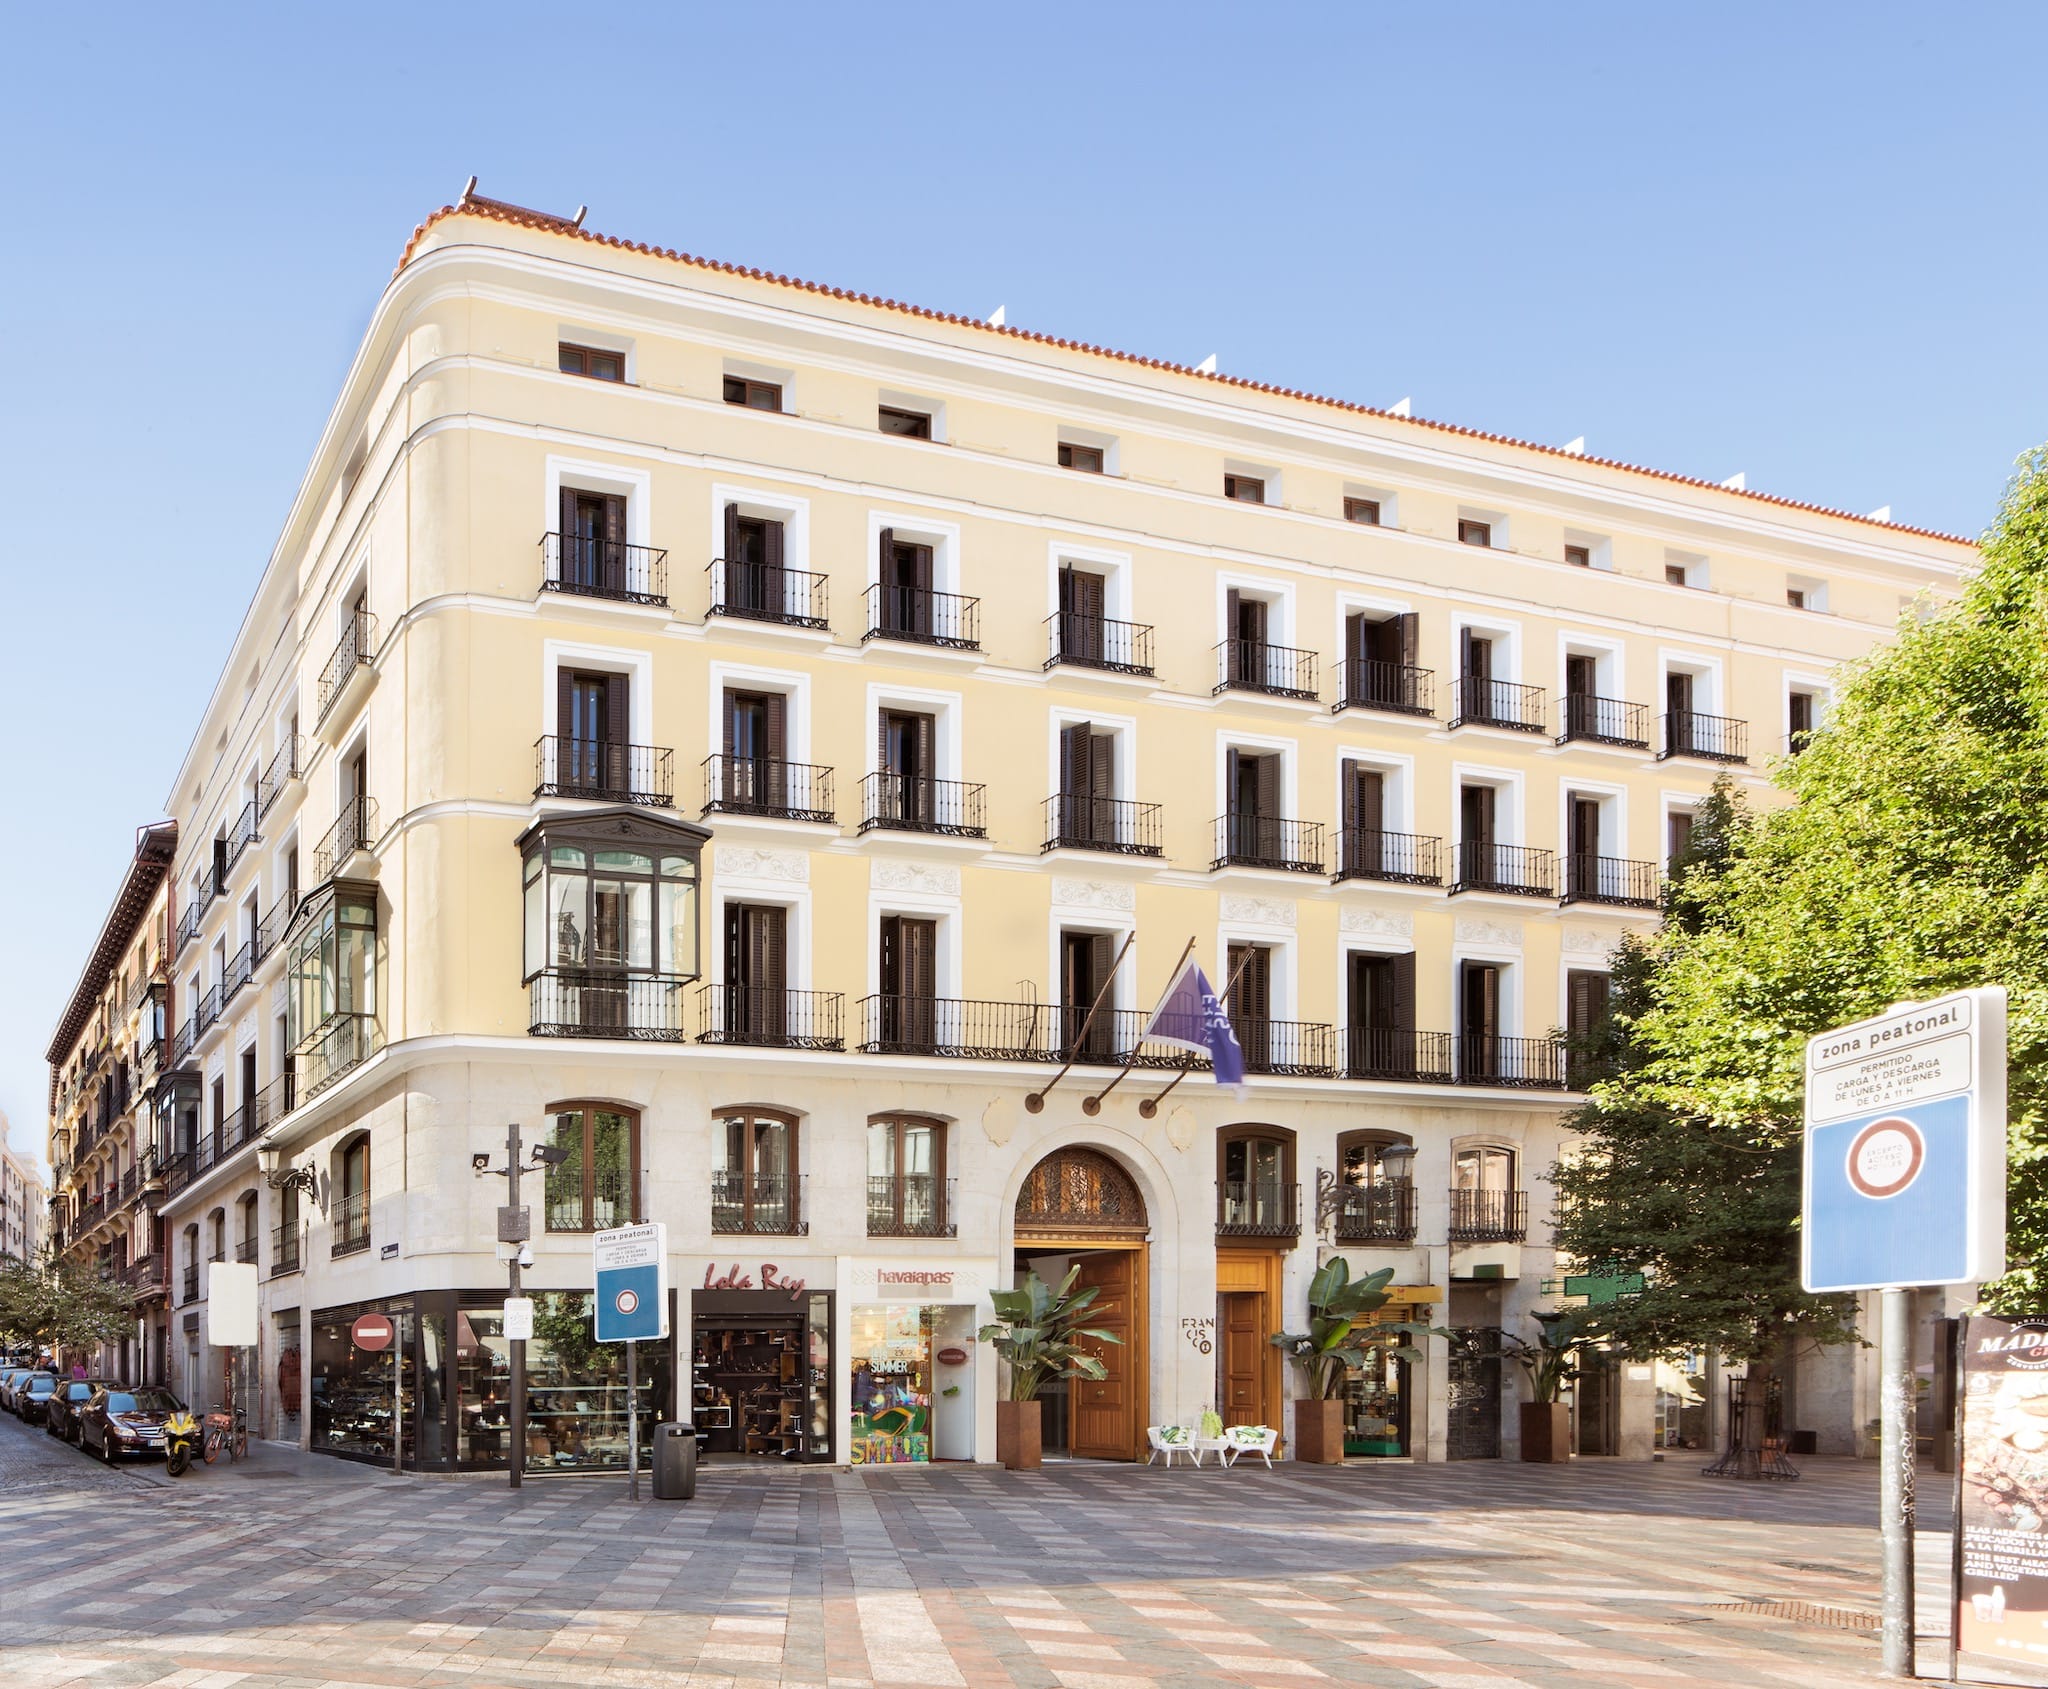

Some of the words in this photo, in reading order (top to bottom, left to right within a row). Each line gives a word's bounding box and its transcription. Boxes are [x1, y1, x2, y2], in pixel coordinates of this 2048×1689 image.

[1822, 1039, 1861, 1059] zona
[1870, 1007, 1958, 1048] peatonal
[1861, 1054, 1913, 1074] PERMITIDO
[1836, 1077, 1869, 1091] CARGA
[1873, 1074, 1879, 1082] Y
[1882, 1058, 1940, 1079] DESCARGA
[1835, 1093, 1847, 1102] DE
[1851, 1083, 1882, 1098] LUNES
[1886, 1081, 1893, 1089] A
[1897, 1069, 1942, 1087] VIERNES
[1857, 1098, 1869, 1107] DE
[1907, 1087, 1913, 1095] H
[620, 1228, 653, 1240] peatonal
[704, 1263, 753, 1290] Lola
[762, 1263, 805, 1300] Rey
[878, 1268, 954, 1286] havaianas
[1182, 1318, 1214, 1328] FRAN
[871, 1360, 908, 1373] SUMMER
[1964, 1552, 1991, 1562] THE
[1993, 1555, 2020, 1565] BEST
[1964, 1560, 1994, 1569] AND
